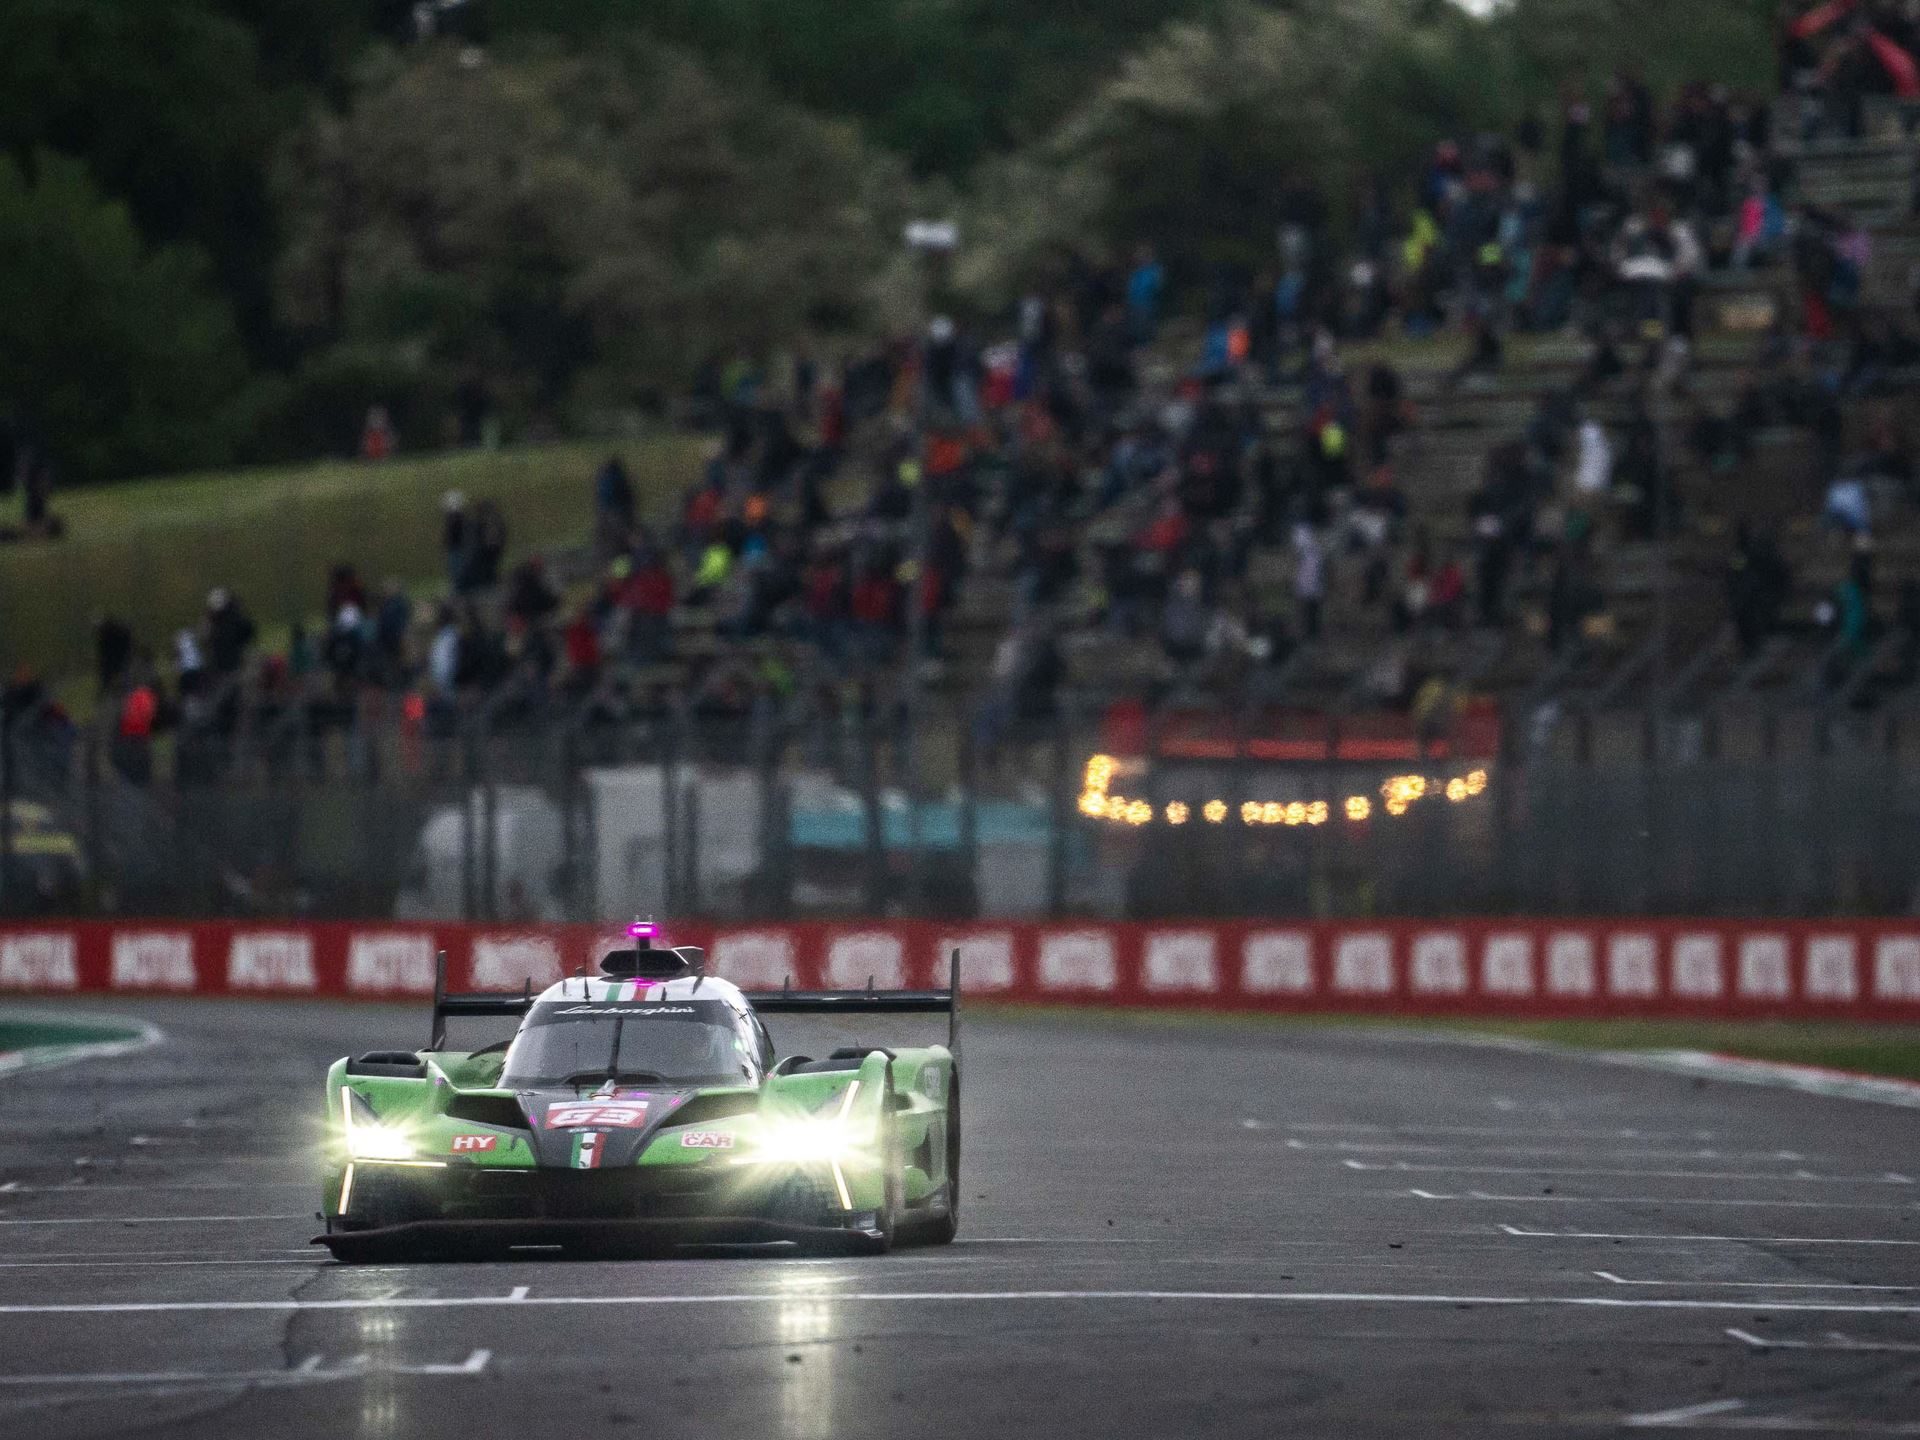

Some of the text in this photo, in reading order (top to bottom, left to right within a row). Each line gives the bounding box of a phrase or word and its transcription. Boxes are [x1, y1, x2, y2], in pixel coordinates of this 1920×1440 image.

[554, 1005, 695, 1015] Lamborghini
[453, 1136, 496, 1150] HY
[684, 1137, 731, 1146] CAR
